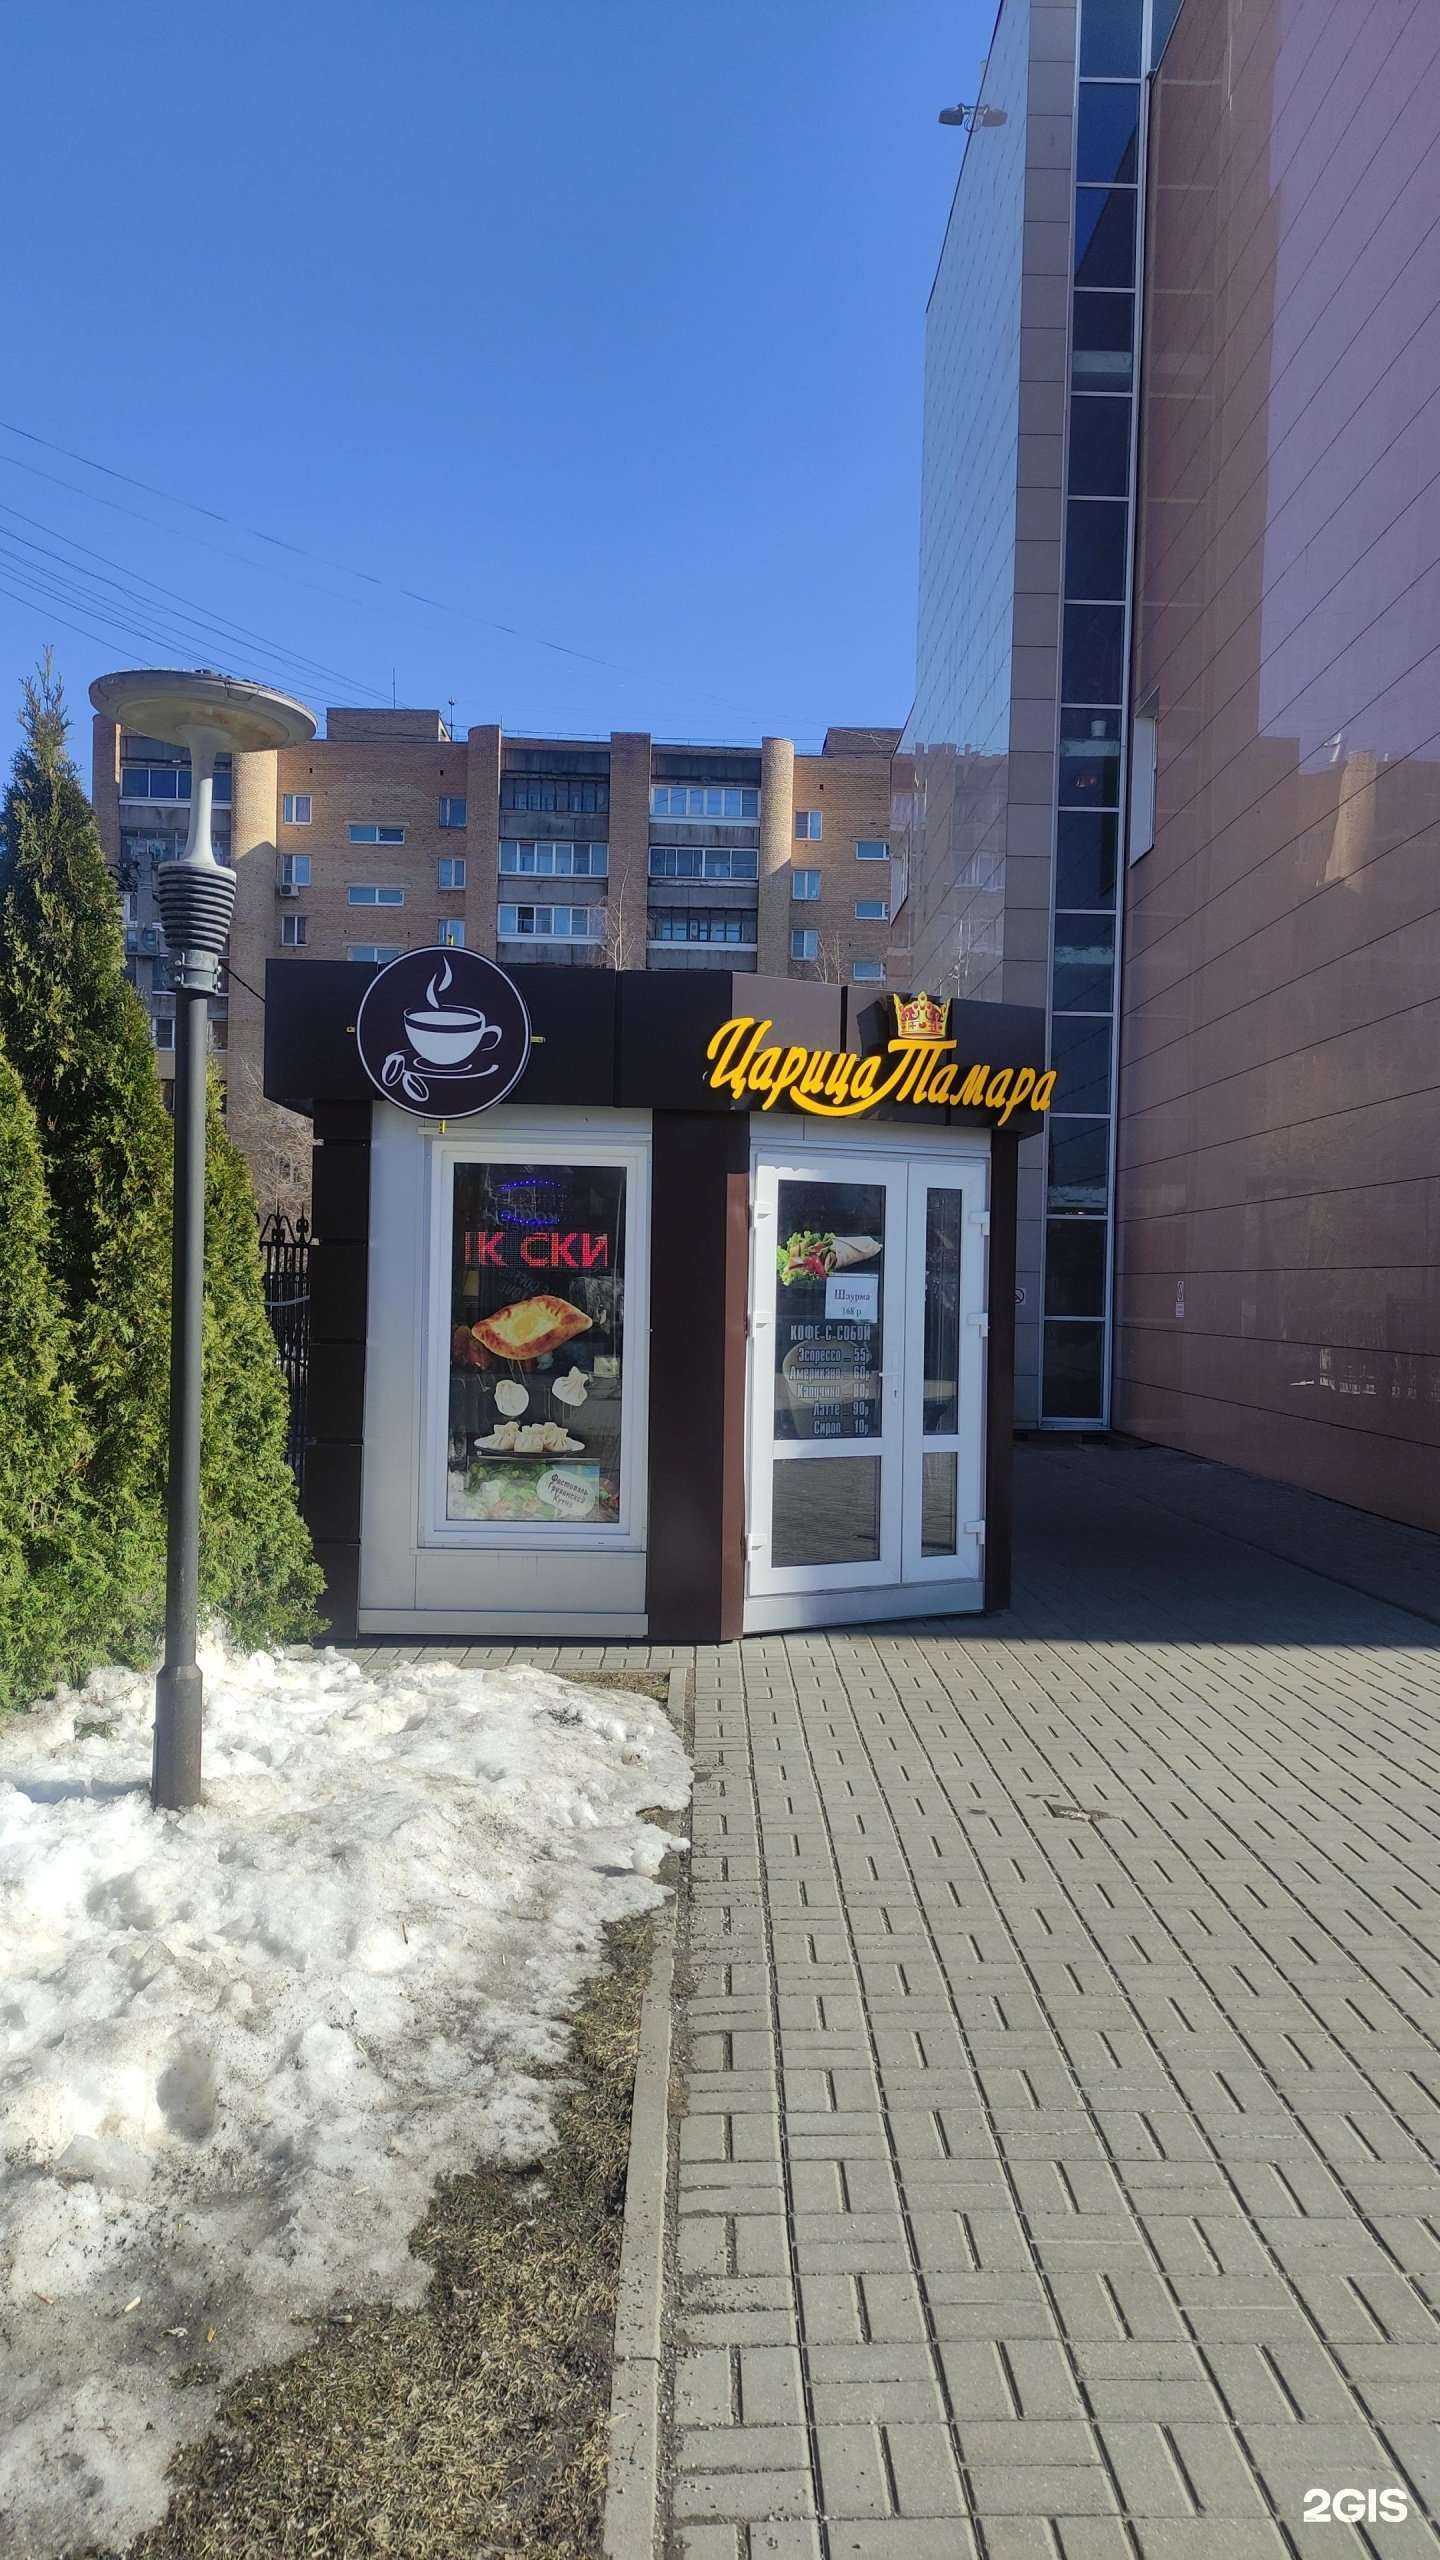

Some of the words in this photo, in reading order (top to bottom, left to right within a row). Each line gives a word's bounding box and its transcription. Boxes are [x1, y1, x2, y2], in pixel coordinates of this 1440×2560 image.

[707, 1017, 882, 1110] Царица
[790, 1039, 1057, 1126] Тамара
[833, 1288, 871, 1304] Шаурма
[813, 1403, 841, 1416] Латте
[813, 1420, 841, 1437] Сироп
